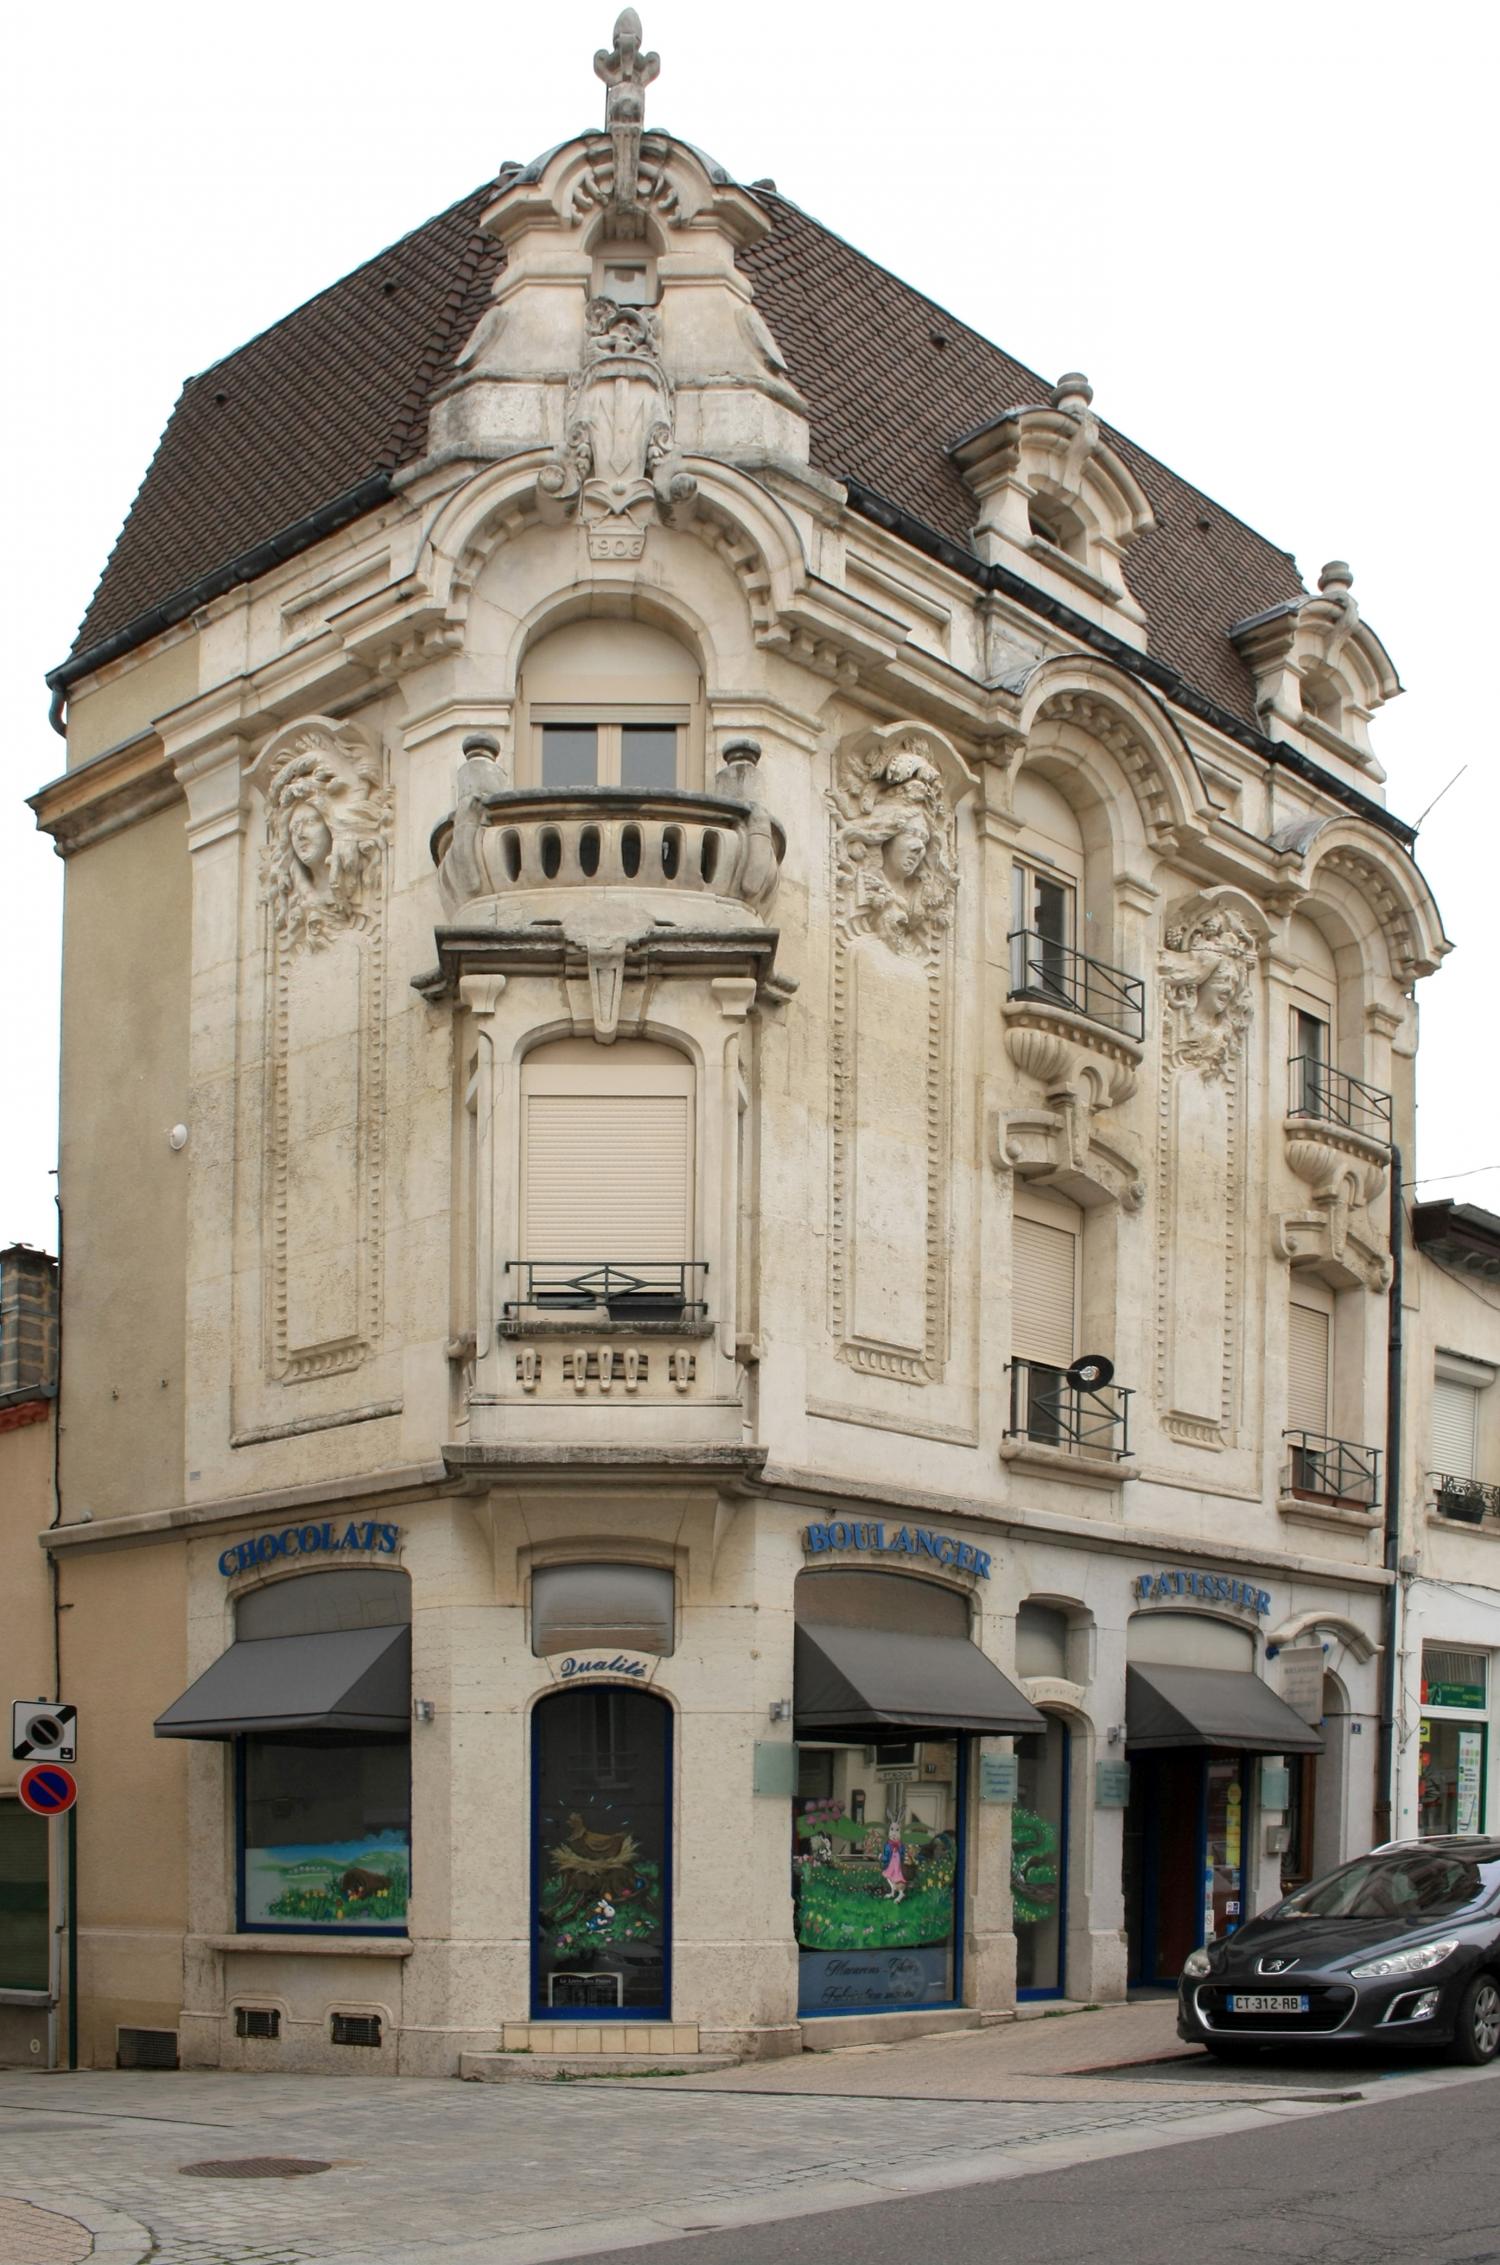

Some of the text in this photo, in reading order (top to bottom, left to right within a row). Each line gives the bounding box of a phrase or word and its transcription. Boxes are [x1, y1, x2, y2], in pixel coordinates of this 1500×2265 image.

[590, 540, 641, 557] 1906
[218, 1521, 399, 1577] CHOCOLATS
[806, 1521, 992, 1580] BOULANGER
[1138, 1571, 1271, 1616] PATISSIER
[561, 1655, 647, 1678] Qualité
